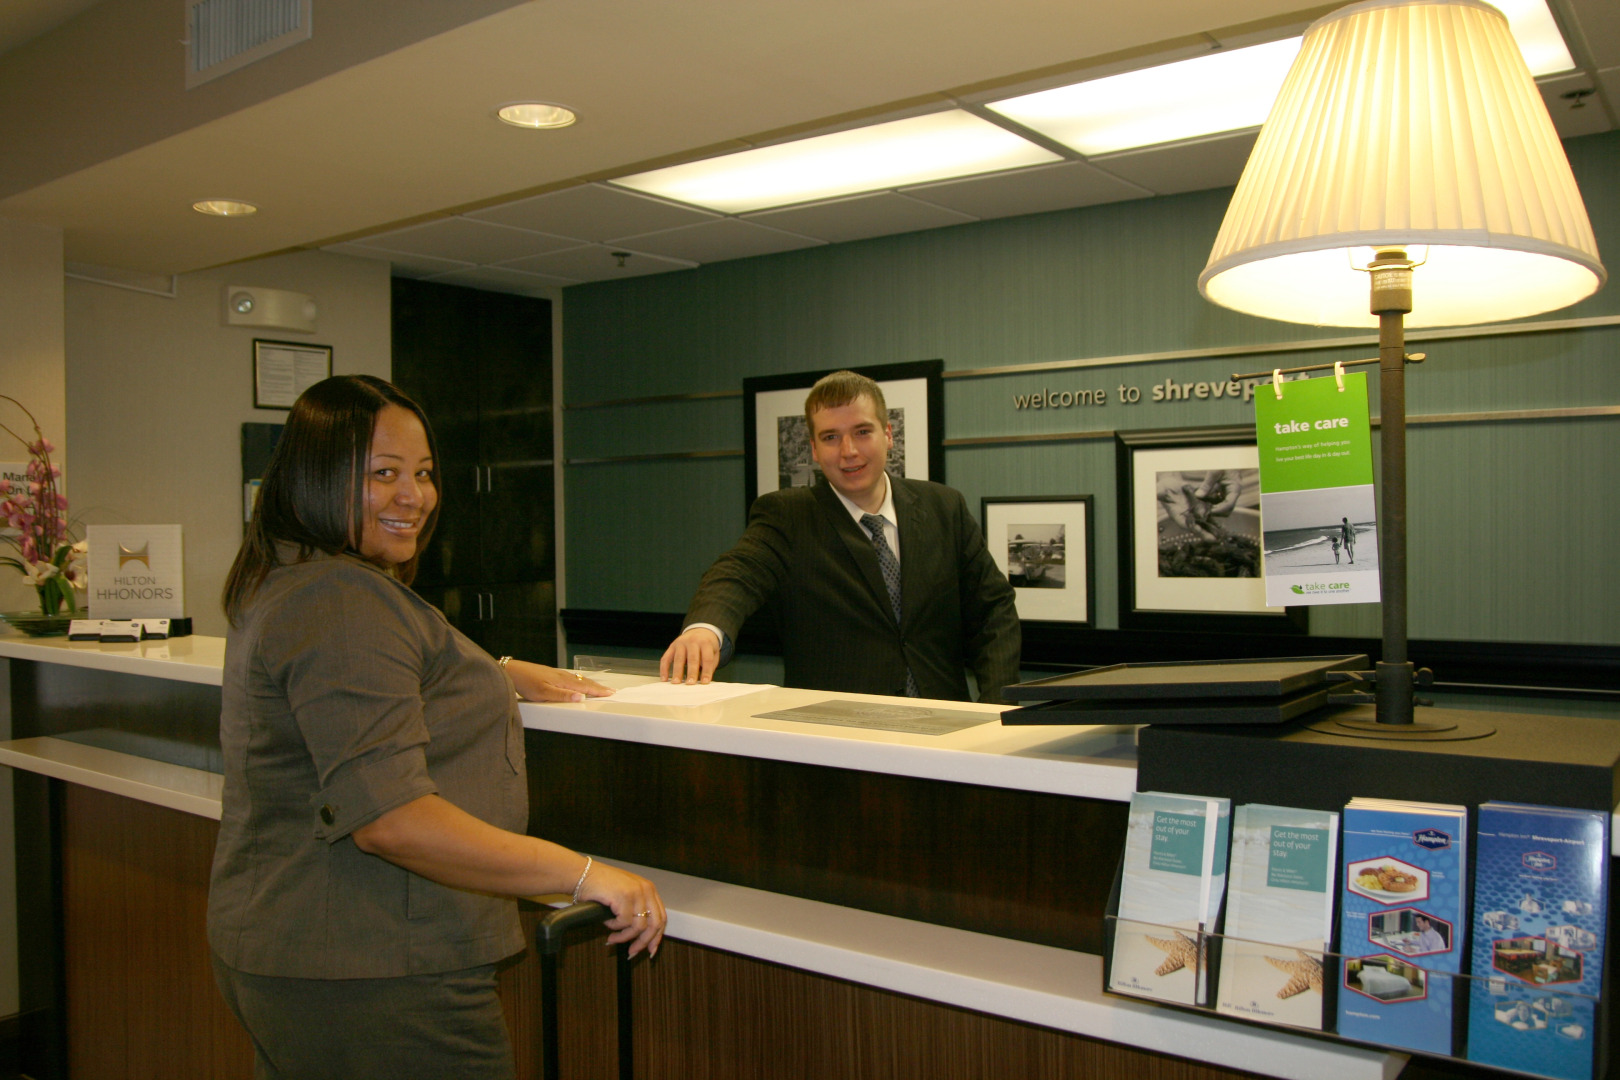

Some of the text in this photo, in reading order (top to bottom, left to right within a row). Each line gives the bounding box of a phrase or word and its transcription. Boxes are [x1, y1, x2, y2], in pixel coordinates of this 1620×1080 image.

[1013, 387, 1106, 409] welcome
[1117, 384, 1141, 403] to
[1274, 417, 1349, 434] take care
[114, 576, 156, 586] HILTON
[1305, 581, 1326, 590] take
[97, 588, 173, 600] HHONORS
[1156, 815, 1197, 827] Get the most
[1167, 826, 1175, 834] of
[1274, 830, 1319, 841] Get the most
[1273, 840, 1286, 848] out
[1287, 841, 1295, 849] of
[1416, 833, 1448, 845] Hampton
